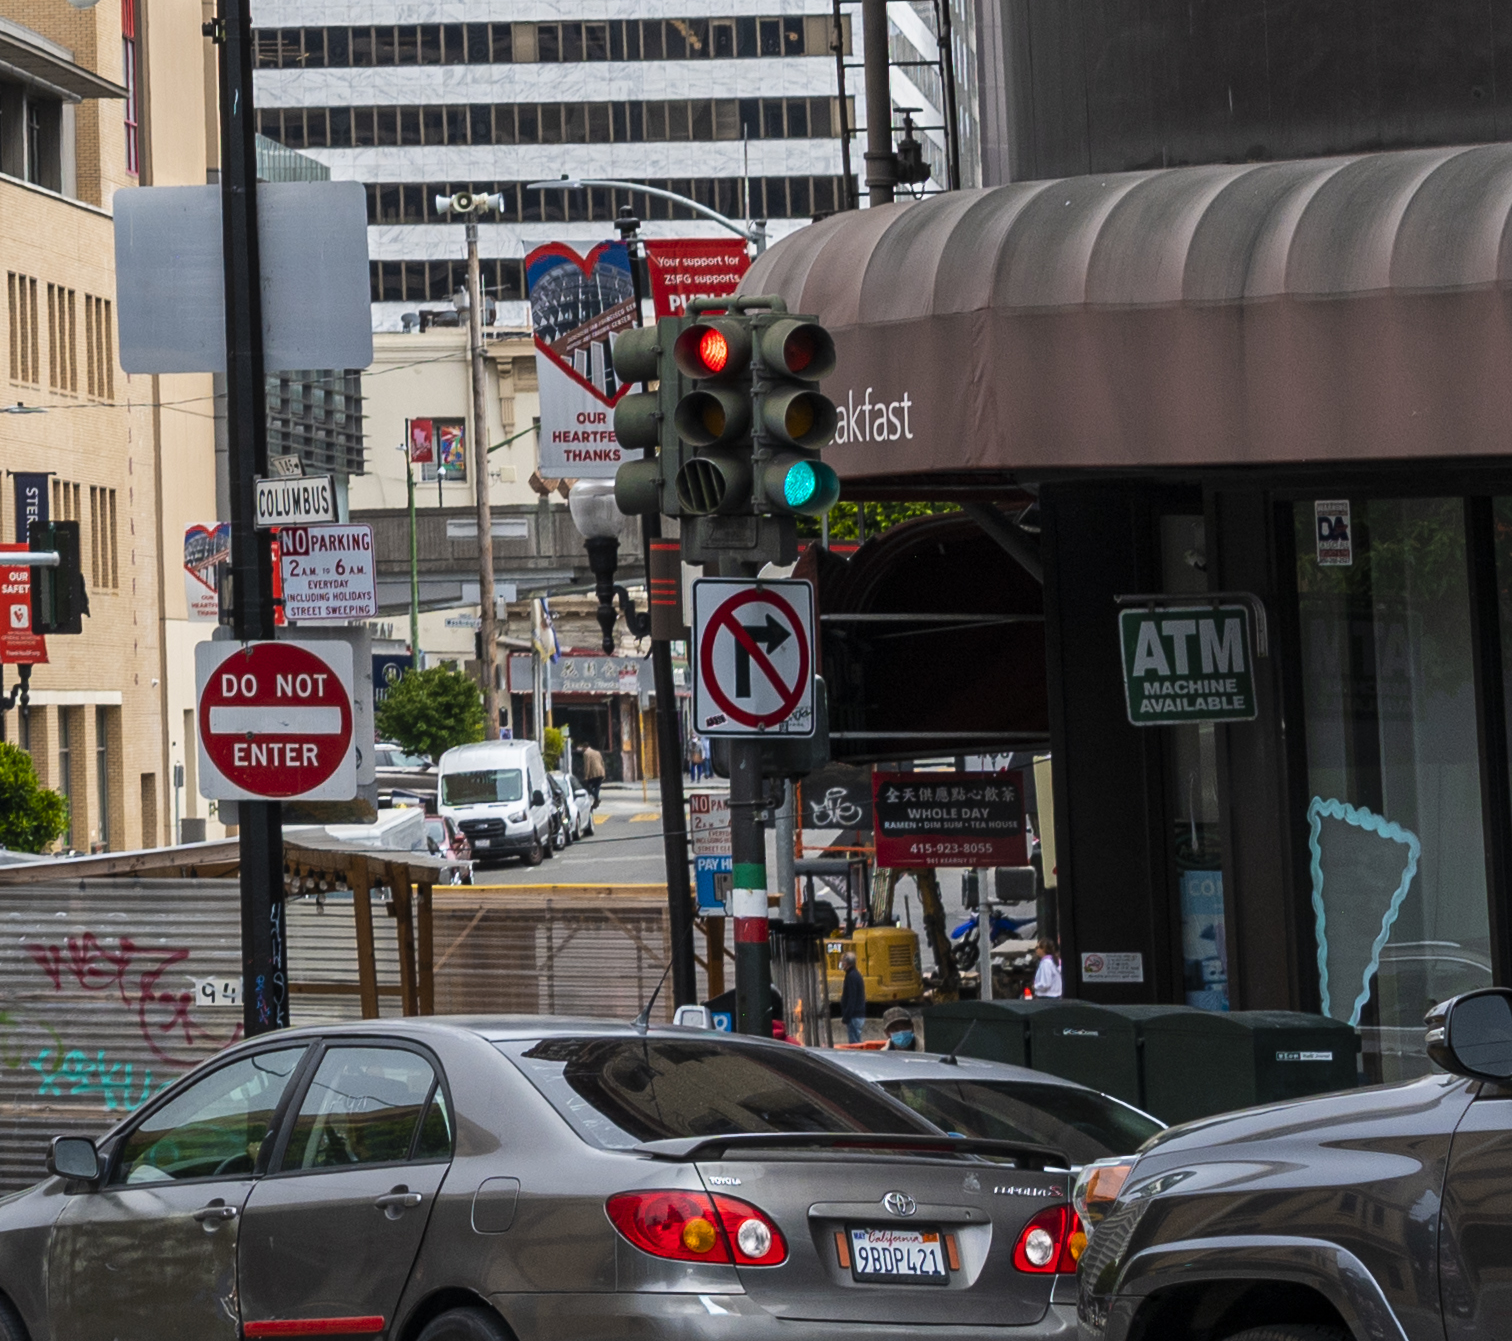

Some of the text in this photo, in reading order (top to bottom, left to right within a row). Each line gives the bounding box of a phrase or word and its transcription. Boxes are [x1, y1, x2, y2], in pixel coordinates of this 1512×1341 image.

[658, 255, 739, 267] Your support for
[664, 273, 740, 285] ZSFG supports
[576, 412, 607, 425] OUR
[830, 387, 913, 445] akfast
[552, 431, 617, 443] HEARTFE
[564, 449, 622, 462] THANKS
[258, 485, 330, 518] COLUMBUS
[281, 530, 370, 555] NO PARKING
[289, 559, 300, 577] 2
[335, 558, 346, 576] 6
[9, 572, 29, 582] OUR
[1, 584, 31, 594] SAFET
[308, 579, 349, 590] EVERYDAY
[287, 591, 372, 602] INCLUDING HOLIDAYS
[290, 605, 371, 616] STREET SWEEPING
[1132, 618, 1245, 677] ATM
[221, 673, 327, 698] DO NOT
[1143, 678, 1238, 695] MACHINE
[1139, 696, 1246, 713] AVAILABLE
[233, 743, 319, 767] ENTER
[691, 796, 708, 812] NO
[907, 808, 990, 818] WHOLE DAY
[694, 817, 702, 828] 2
[884, 820, 1018, 829] RAMEN DIM SUM TEA HOUSE
[910, 843, 993, 854] 415-923-8055
[698, 858, 719, 871] PAY
[202, 982, 244, 1004] 94
[709, 1175, 742, 1186] TOYOTA
[868, 1229, 923, 1248] California
[858, 1246, 942, 1275] 9BDP421
